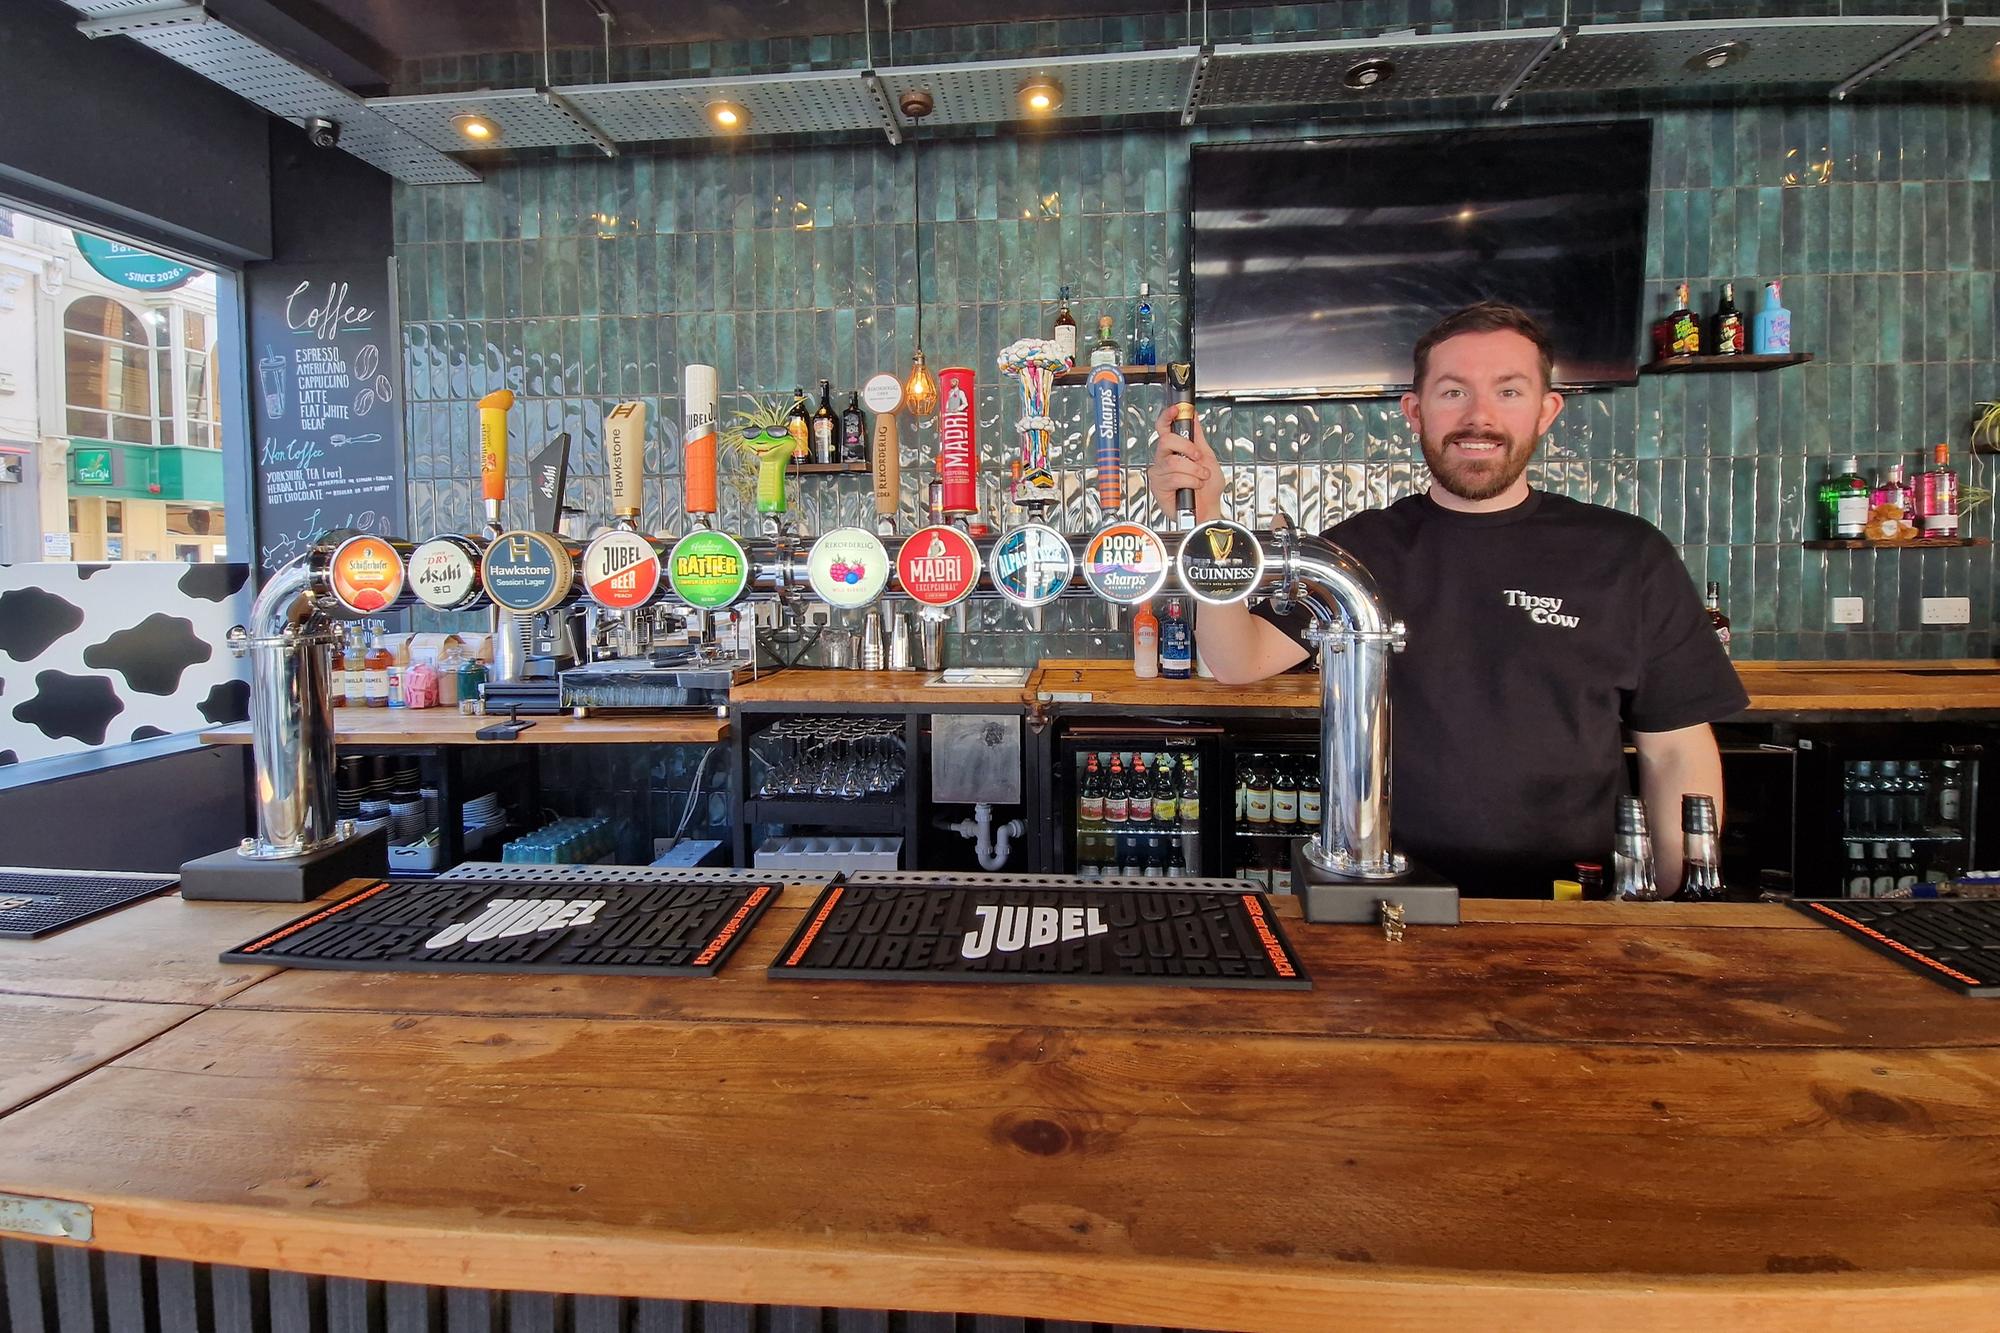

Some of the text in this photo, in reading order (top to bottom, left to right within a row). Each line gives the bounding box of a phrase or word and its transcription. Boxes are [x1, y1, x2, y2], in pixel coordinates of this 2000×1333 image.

[286, 280, 376, 340] Coffee
[295, 346, 340, 363] ESPRESSO
[296, 360, 347, 376] AMERICANO
[298, 374, 350, 390] CAPPUCCINO
[299, 389, 328, 404] LATTE
[300, 404, 350, 420] FLAT WHITE
[1099, 389, 1117, 439] Sharp's
[301, 417, 326, 431] DECAF
[261, 437, 325, 469] Non Coffee
[878, 426, 888, 490] REKORDERLIG
[612, 428, 624, 498] Hawkstone
[266, 469, 304, 484] YORKSHIRE
[305, 467, 320, 480] TEA
[540, 464, 557, 499] Asahi
[267, 482, 294, 494] HERBAL
[294, 480, 307, 491] TEA
[268, 493, 283, 505] HOT
[284, 488, 323, 502] CHOCOLATE
[1102, 535, 1145, 551] DOOM
[602, 546, 642, 576] JUBEL
[677, 554, 738, 577] RATTLER
[1102, 550, 1134, 566] BAR
[419, 563, 461, 584] Asahi
[489, 565, 551, 576] Hawkstone
[1187, 565, 1257, 580] GUINNESS
[496, 578, 546, 588] Session Lager
[610, 569, 637, 590] BEER
[1103, 572, 1146, 588] Sharp's
[1503, 590, 1563, 613] Tipsy
[1531, 607, 1580, 628] Cow
[425, 899, 605, 949] JUBEL
[961, 906, 1108, 959] JUBEL
